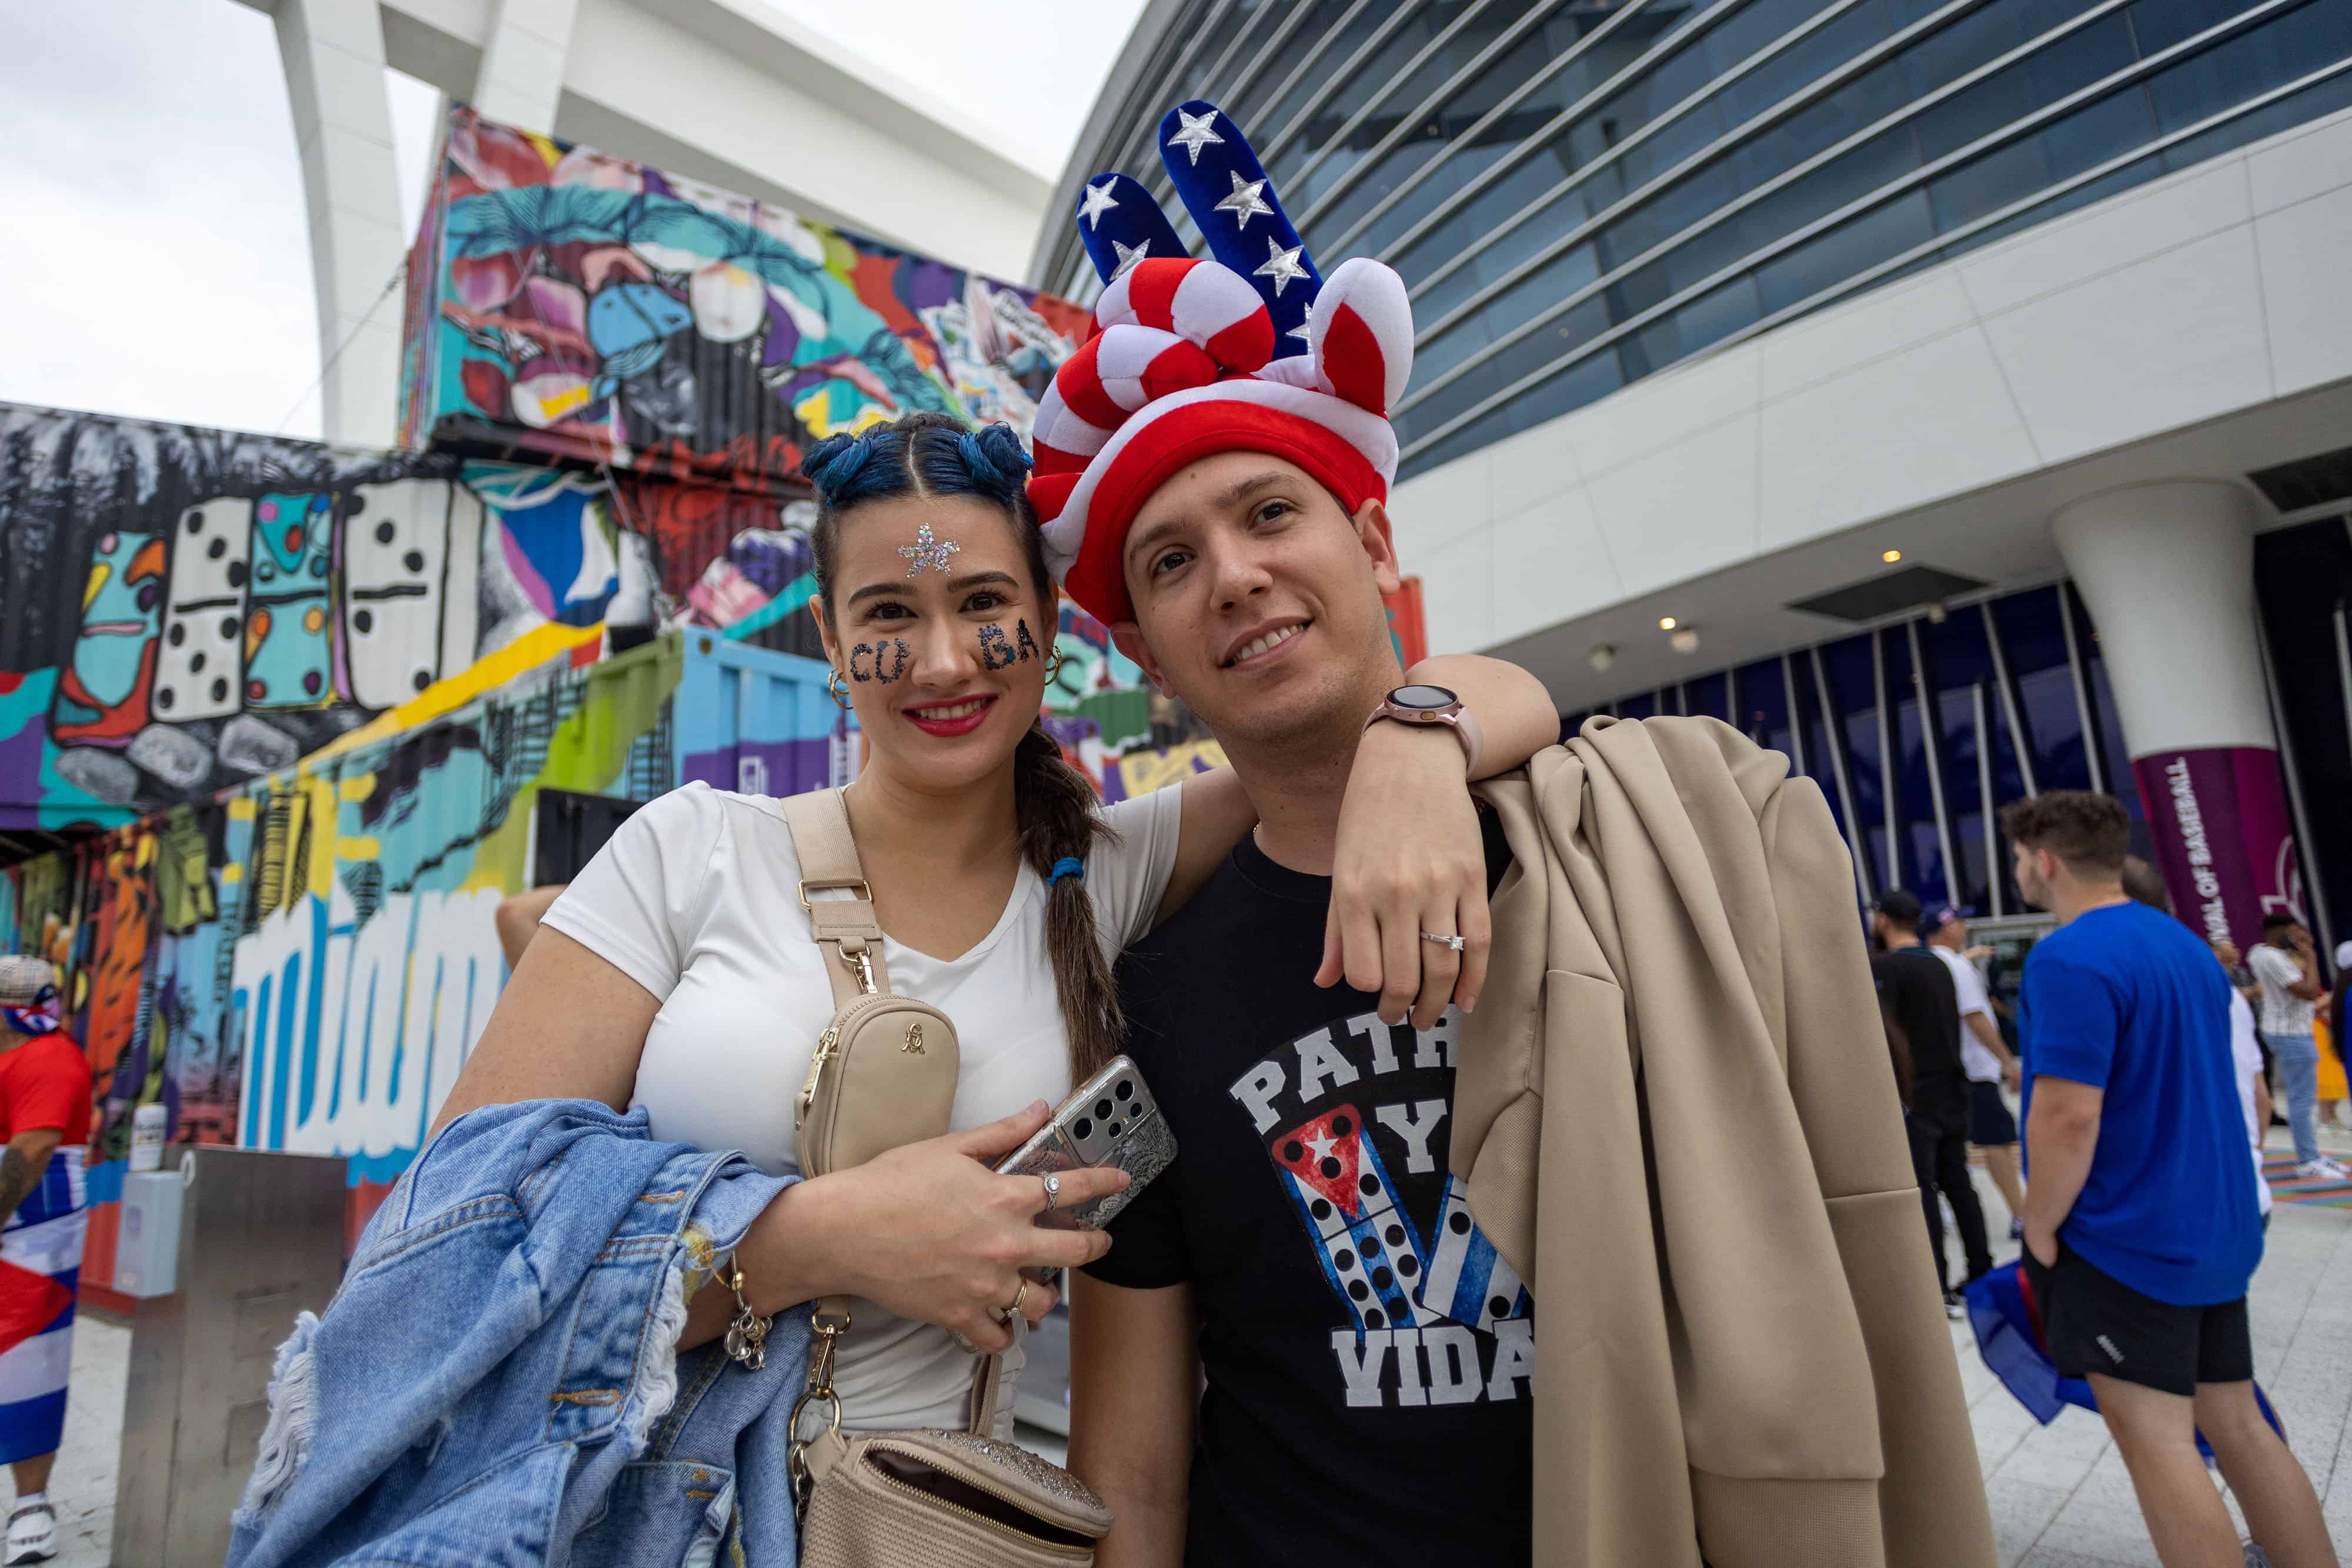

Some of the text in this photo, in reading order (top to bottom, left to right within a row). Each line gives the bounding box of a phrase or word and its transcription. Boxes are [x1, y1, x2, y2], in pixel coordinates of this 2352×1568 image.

[2164, 756, 2212, 865] BASEBALL
[2191, 865, 2220, 898] OF
[1375, 1098, 1448, 1174] Y
[1331, 1318, 1536, 1407] VIDA
